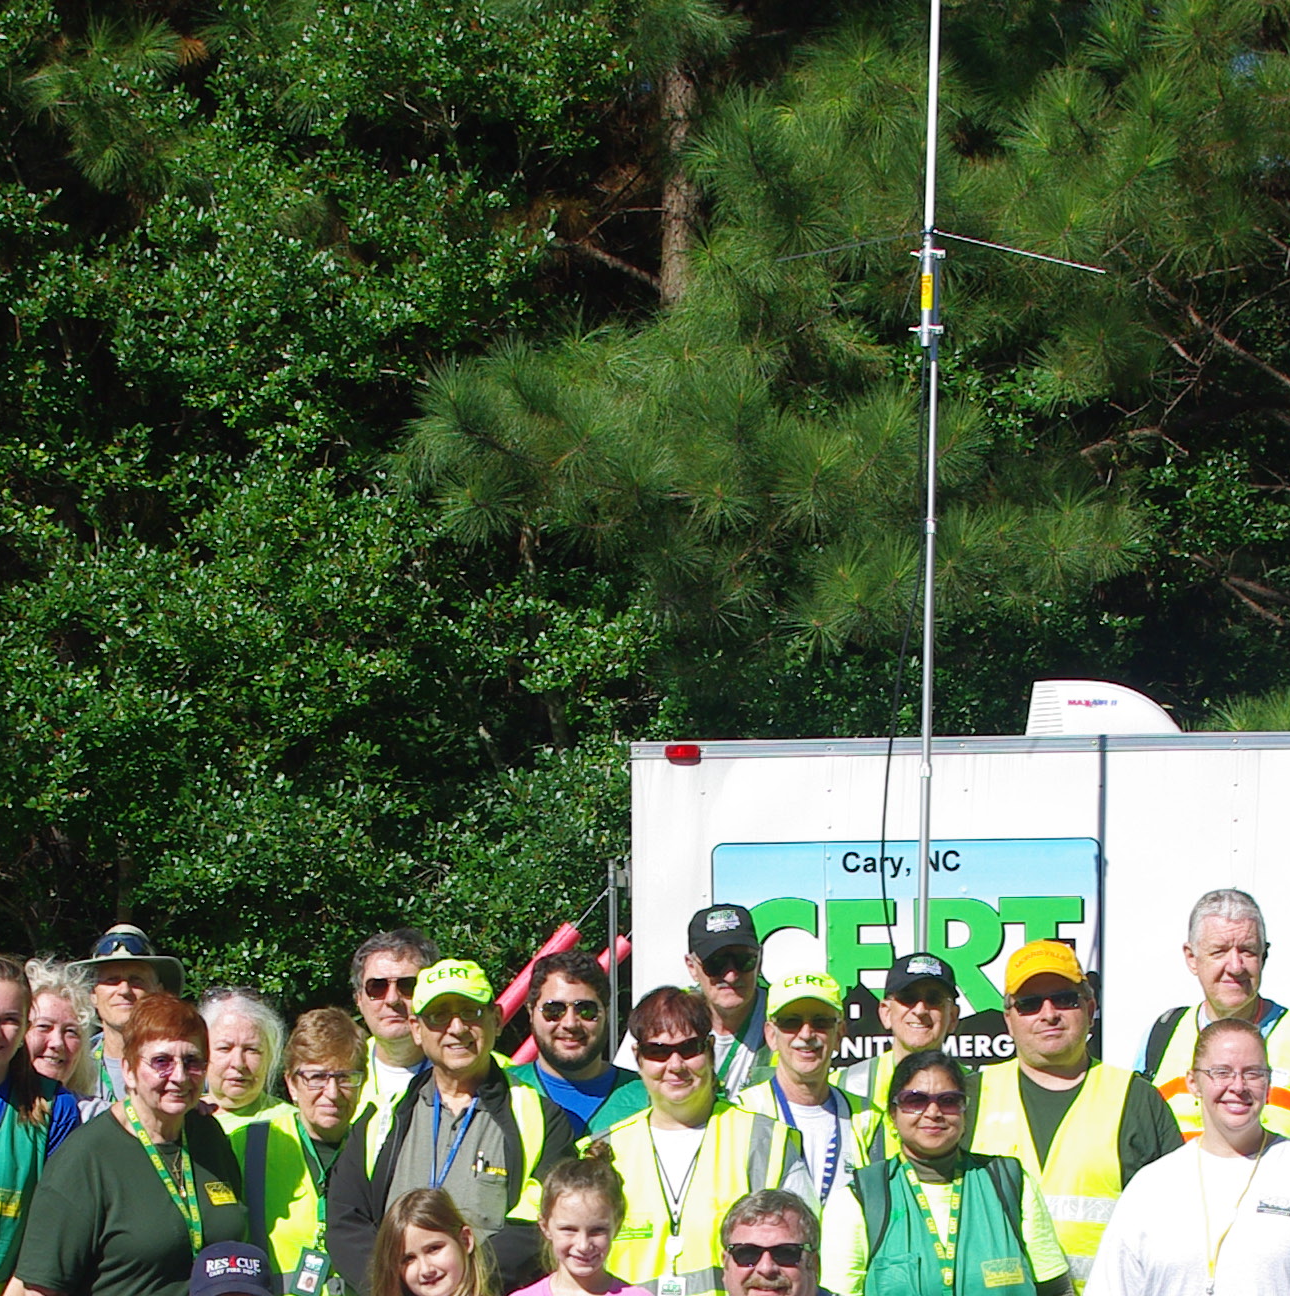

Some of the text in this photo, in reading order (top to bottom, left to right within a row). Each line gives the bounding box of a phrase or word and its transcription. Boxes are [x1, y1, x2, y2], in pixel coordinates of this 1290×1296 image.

[842, 851, 911, 879] Cary,
[427, 967, 469, 984] CERT
[784, 974, 824, 988] CERT
[941, 1034, 1015, 1058] MERG
